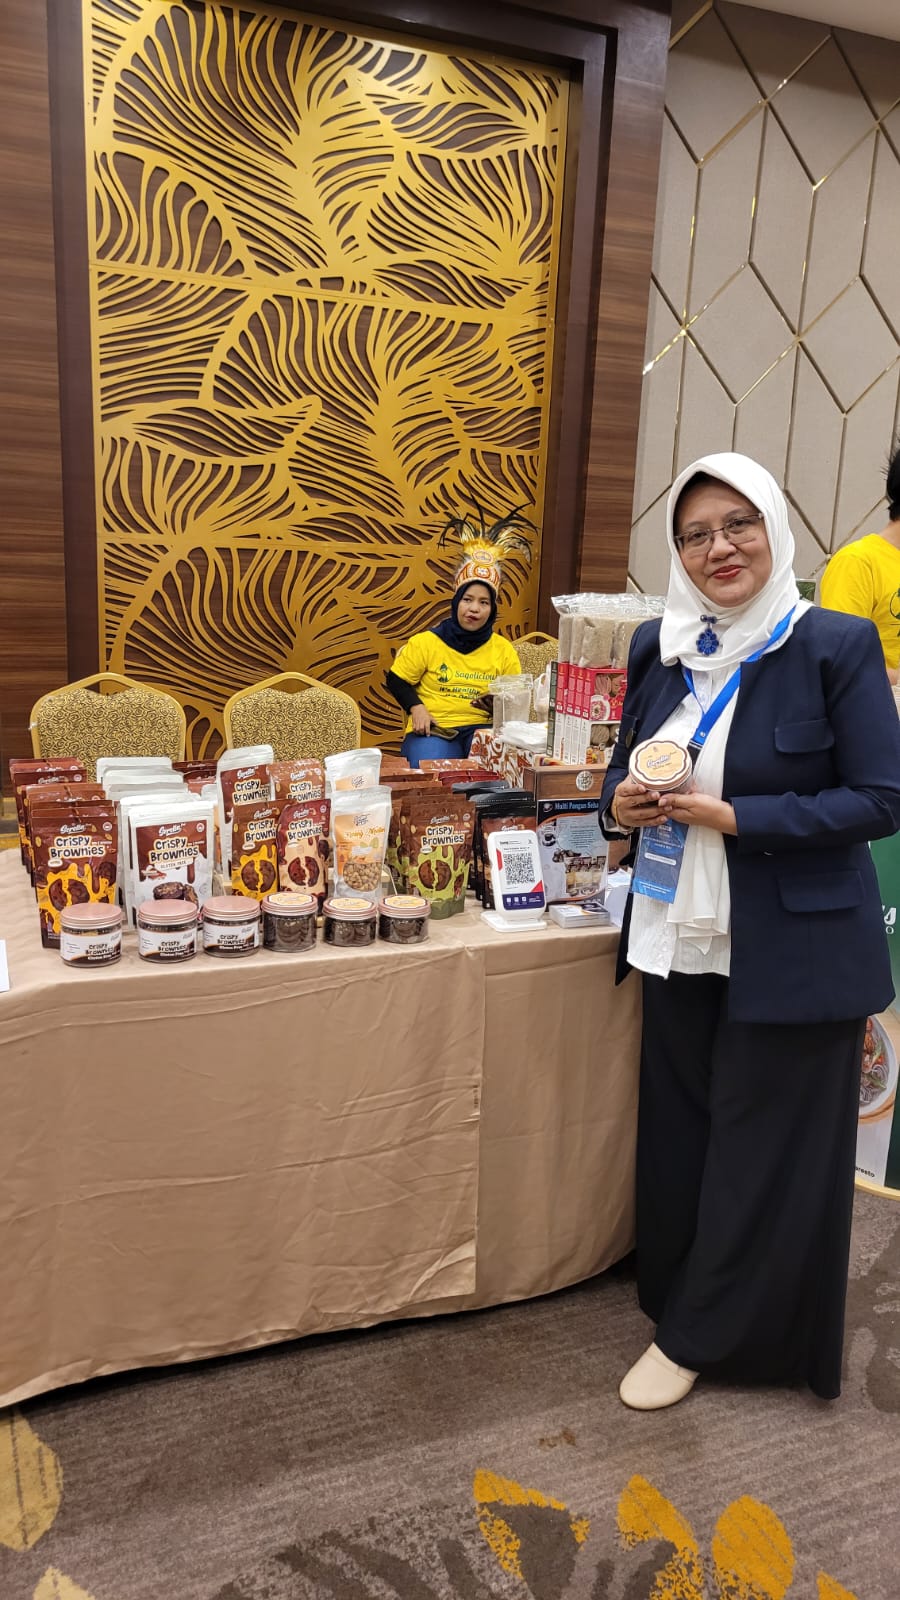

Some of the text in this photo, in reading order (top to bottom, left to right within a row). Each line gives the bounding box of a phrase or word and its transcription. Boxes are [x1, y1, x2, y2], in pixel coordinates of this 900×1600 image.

[455, 671, 497, 681] Sagoliciou
[235, 780, 260, 792] Crispy
[290, 782, 312, 792] Crispy
[233, 789, 270, 803] Brownies
[288, 789, 321, 802] Brownies
[587, 801, 600, 809] Seha
[248, 819, 274, 831] Crispy
[289, 819, 312, 830] Crispy
[245, 829, 276, 842] Browni
[287, 827, 322, 840] Brownies
[427, 826, 453, 836] Crispy
[56, 836, 90, 847] Crispy
[155, 838, 187, 850] Crispy
[422, 835, 464, 846] Brownies
[50, 846, 104, 858] Brownies
[150, 847, 199, 862] Brownies
